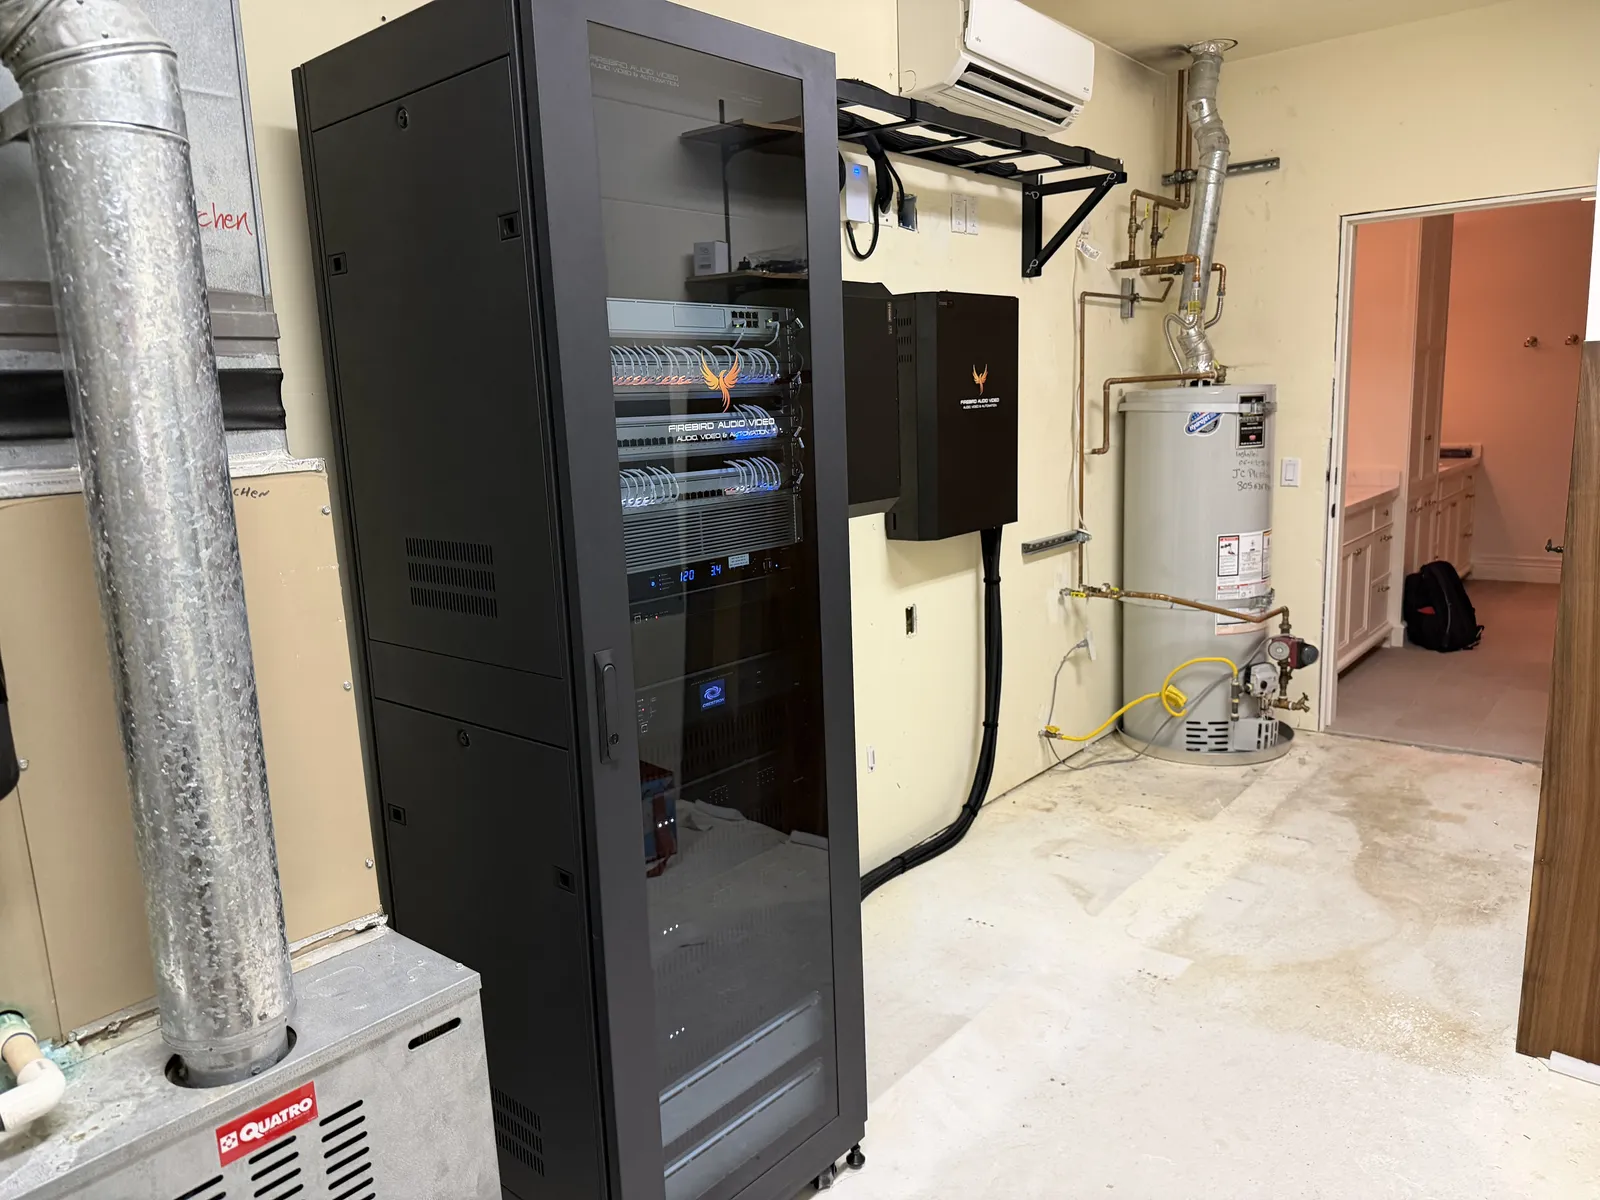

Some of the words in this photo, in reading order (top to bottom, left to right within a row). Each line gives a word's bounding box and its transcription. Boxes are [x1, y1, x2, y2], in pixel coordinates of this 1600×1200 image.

[630, 65, 654, 76] AUDIO
[656, 71, 679, 82] VIDEO
[198, 202, 253, 236] chen
[668, 422, 714, 433] FIREBIRD
[718, 419, 746, 429] AUDIO
[746, 418, 775, 427] VIDEO
[729, 429, 770, 438] AUTOMATION
[680, 569, 695, 582] 120
[240, 1097, 313, 1142] QUATRO
